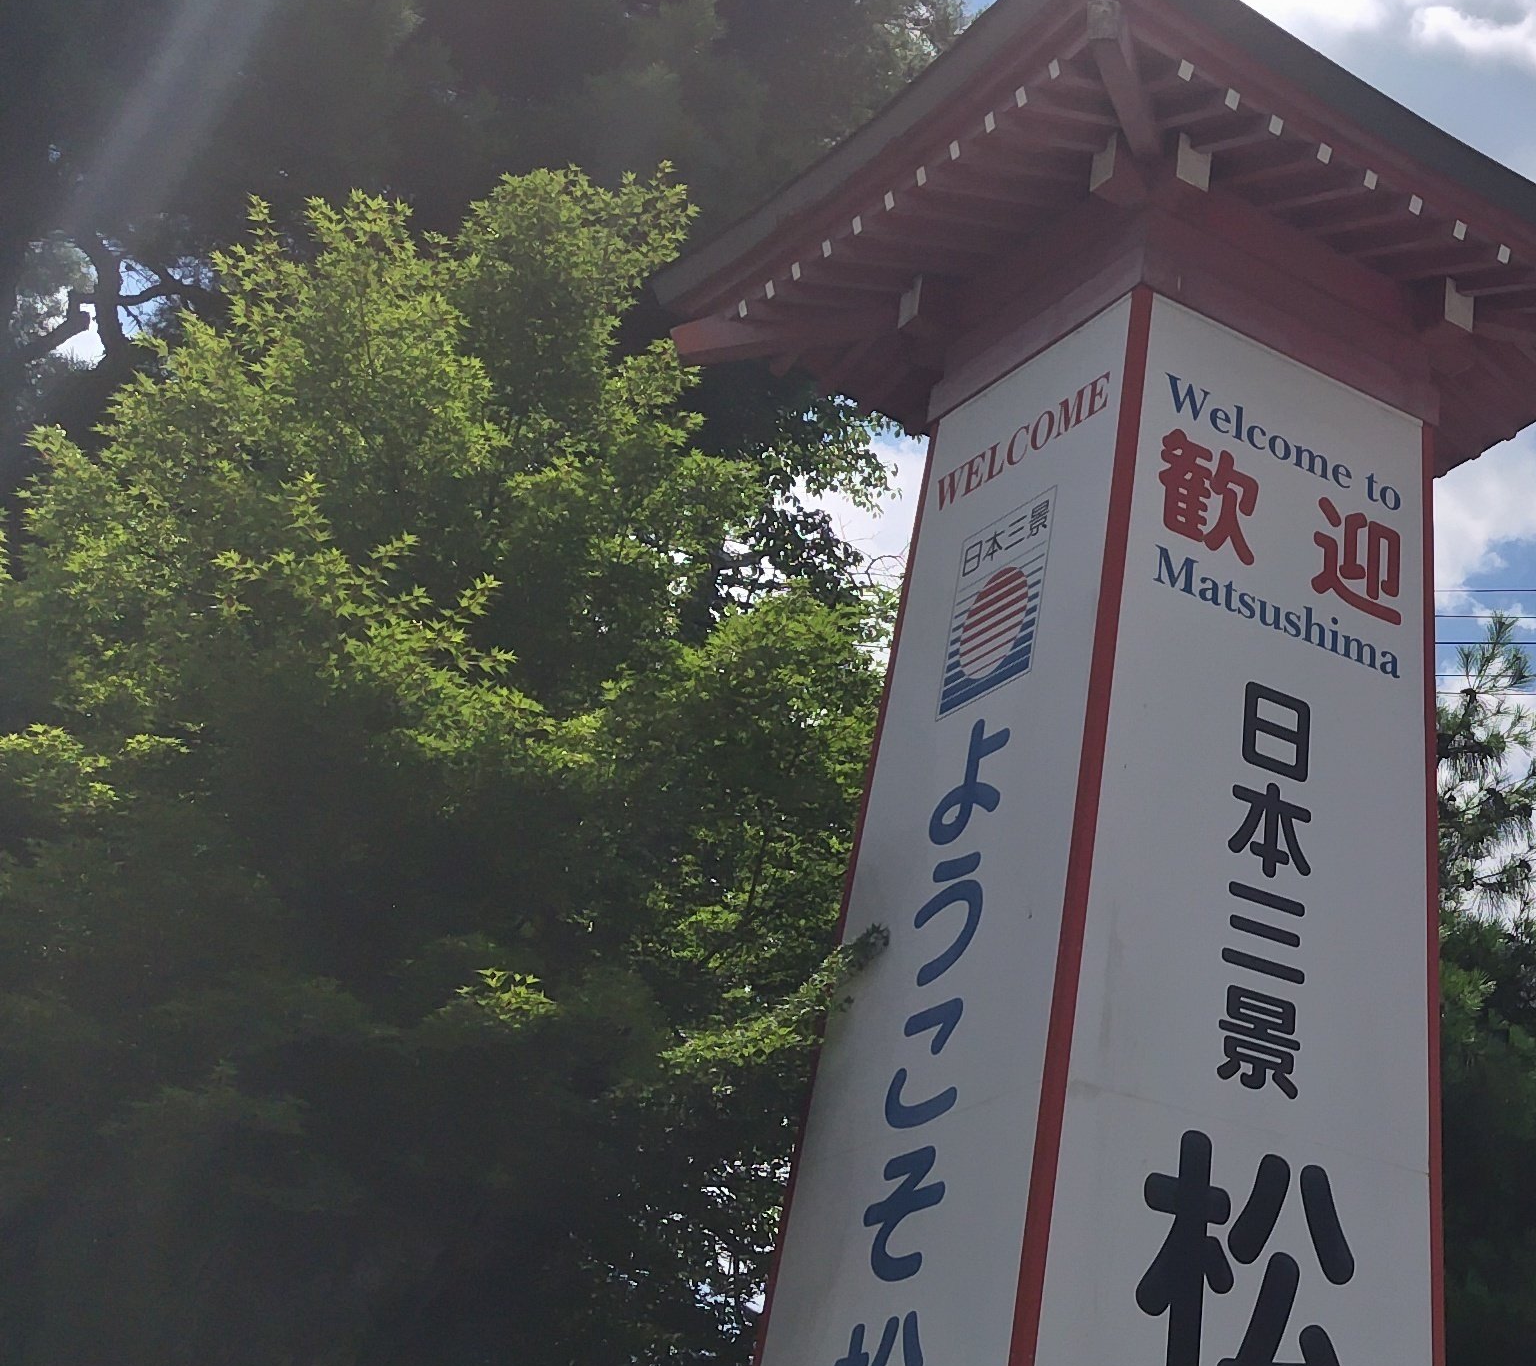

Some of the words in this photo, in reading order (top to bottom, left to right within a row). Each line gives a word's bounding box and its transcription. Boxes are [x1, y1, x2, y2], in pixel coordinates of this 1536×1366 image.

[937, 372, 1111, 511] WELCOME
[1164, 372, 1352, 490] Welcome
[1366, 471, 1402, 511] to
[962, 499, 1050, 577] 日本三景
[1157, 428, 1402, 626] 歓迎
[1153, 544, 1401, 679] Matsushima
[1216, 681, 1313, 1100] 日本三景
